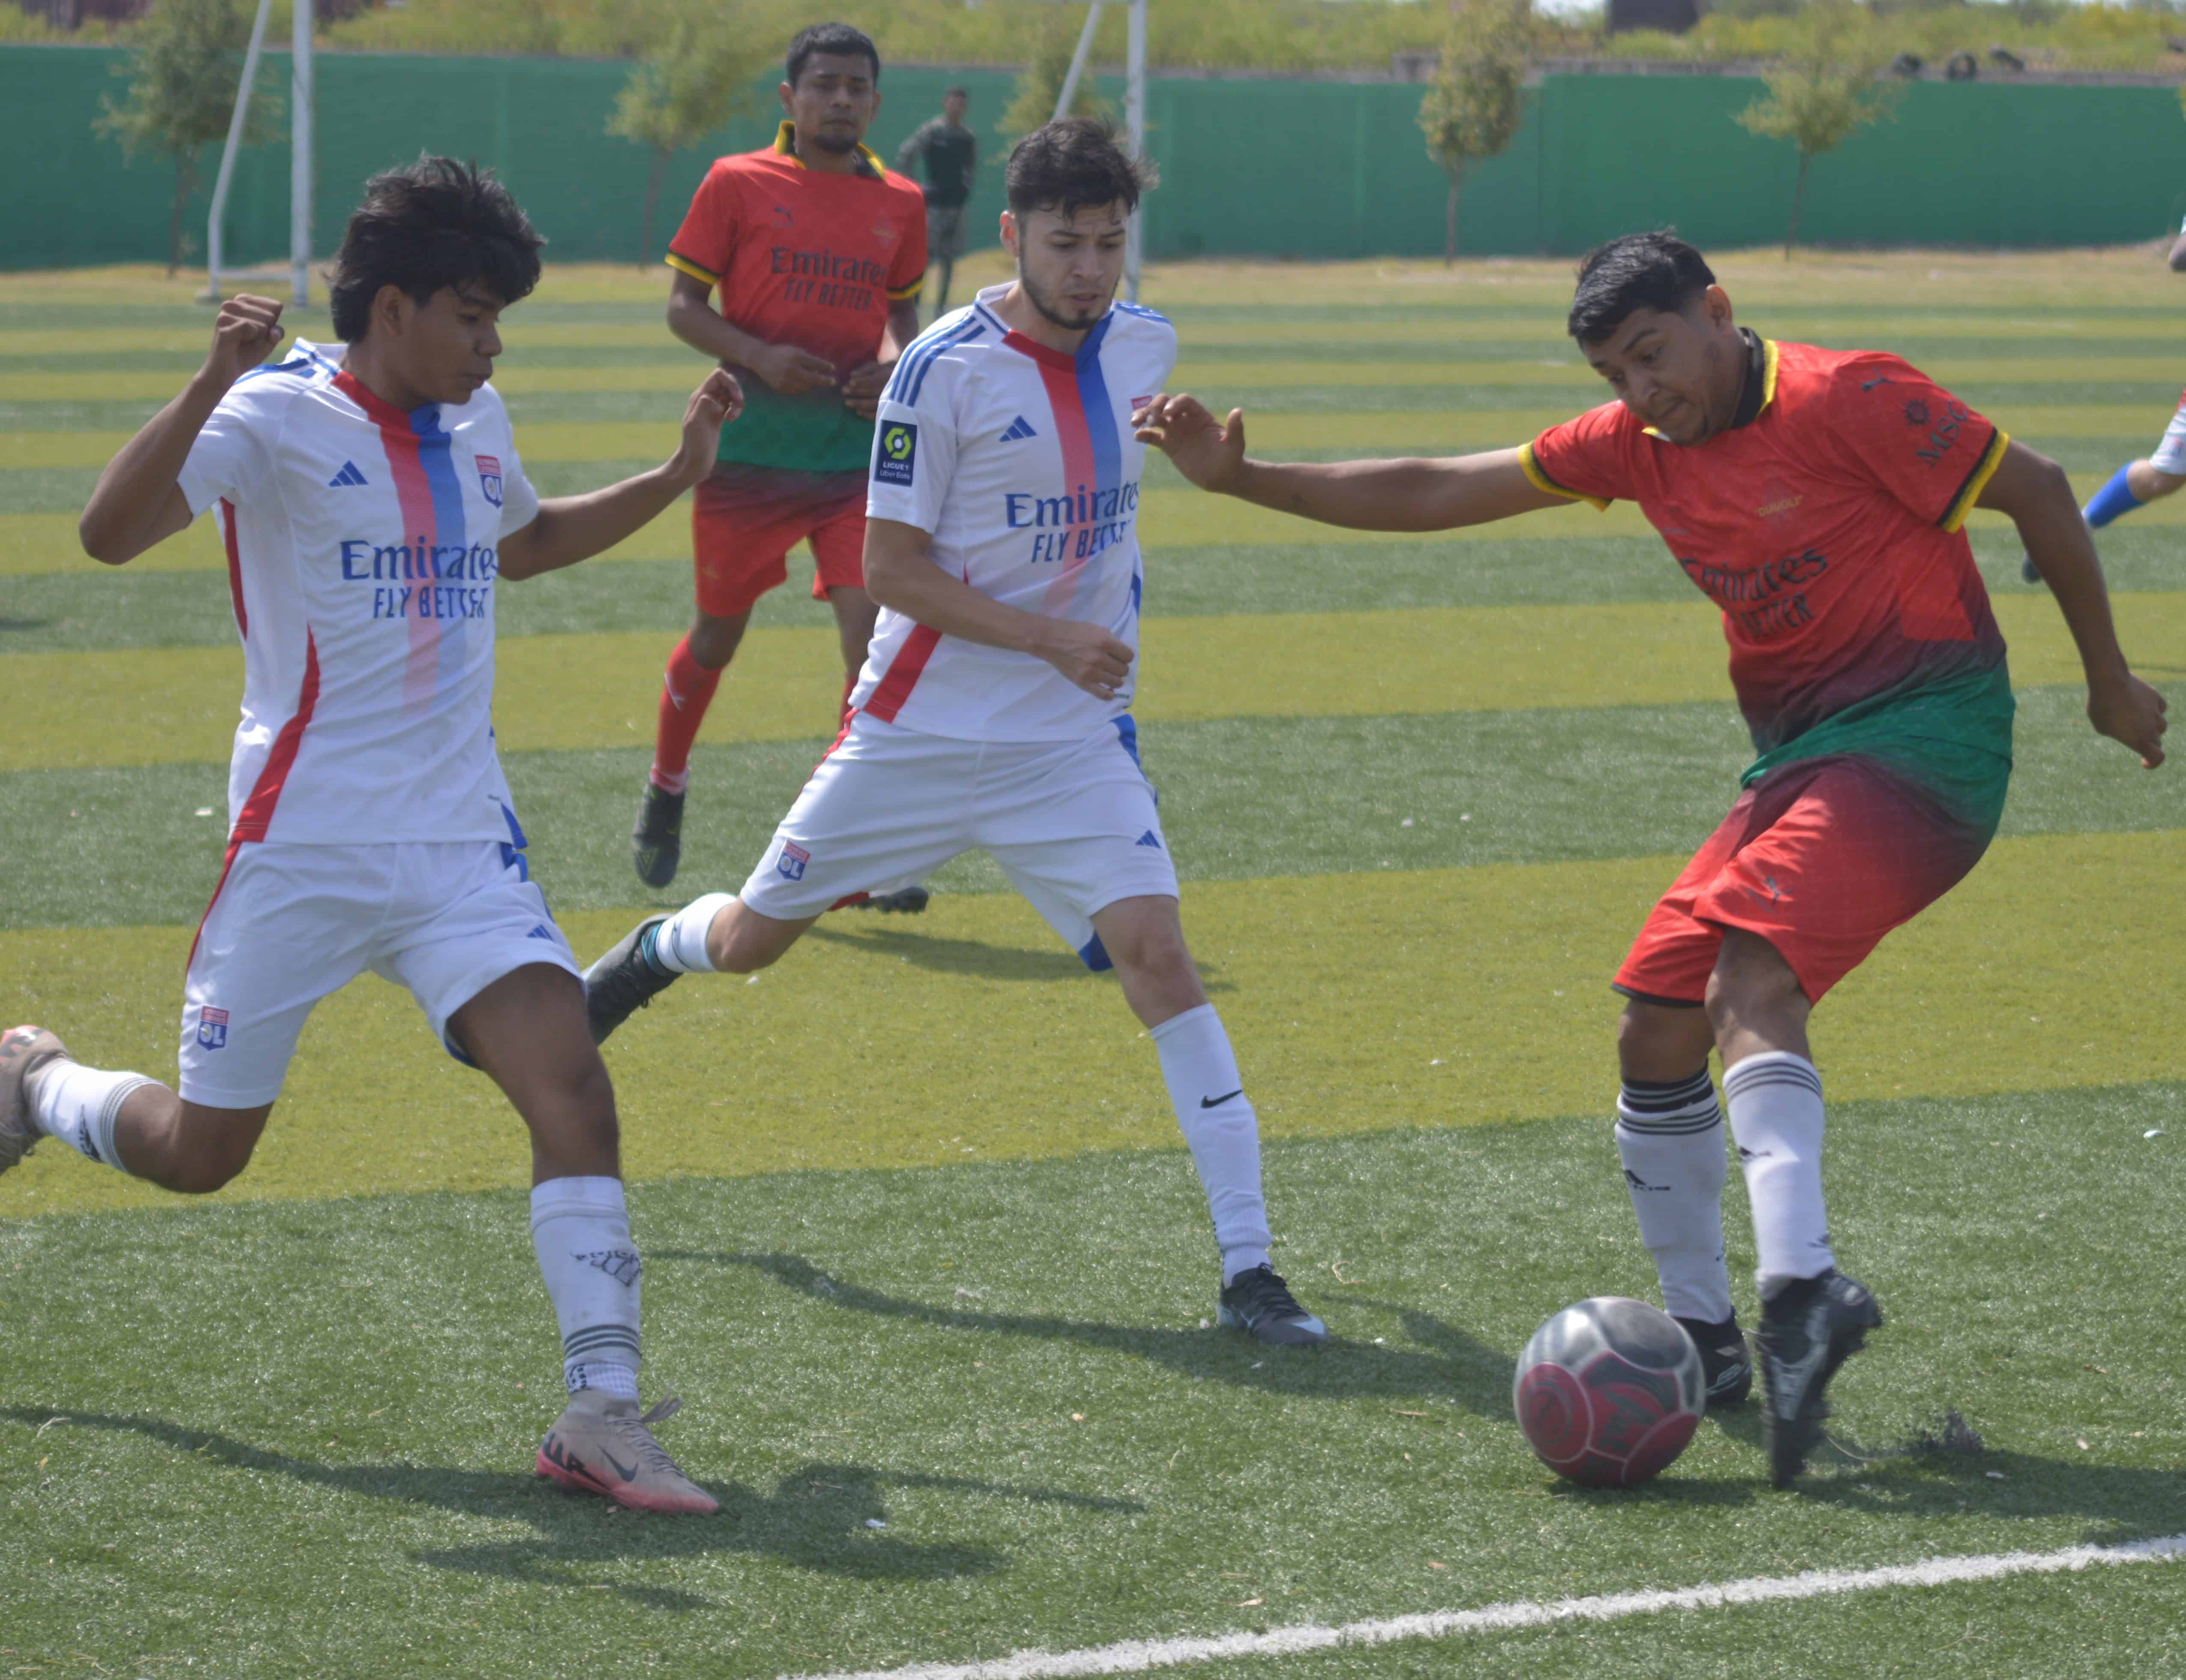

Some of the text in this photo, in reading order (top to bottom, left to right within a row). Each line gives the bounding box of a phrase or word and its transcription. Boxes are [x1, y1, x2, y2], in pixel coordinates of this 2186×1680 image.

[883, 462, 904, 470] LIGUE
[896, 472, 910, 480] Eats
[1031, 531, 1069, 563] FLY
[374, 588, 411, 619] FLY
[199, 1023, 223, 1045] OL
